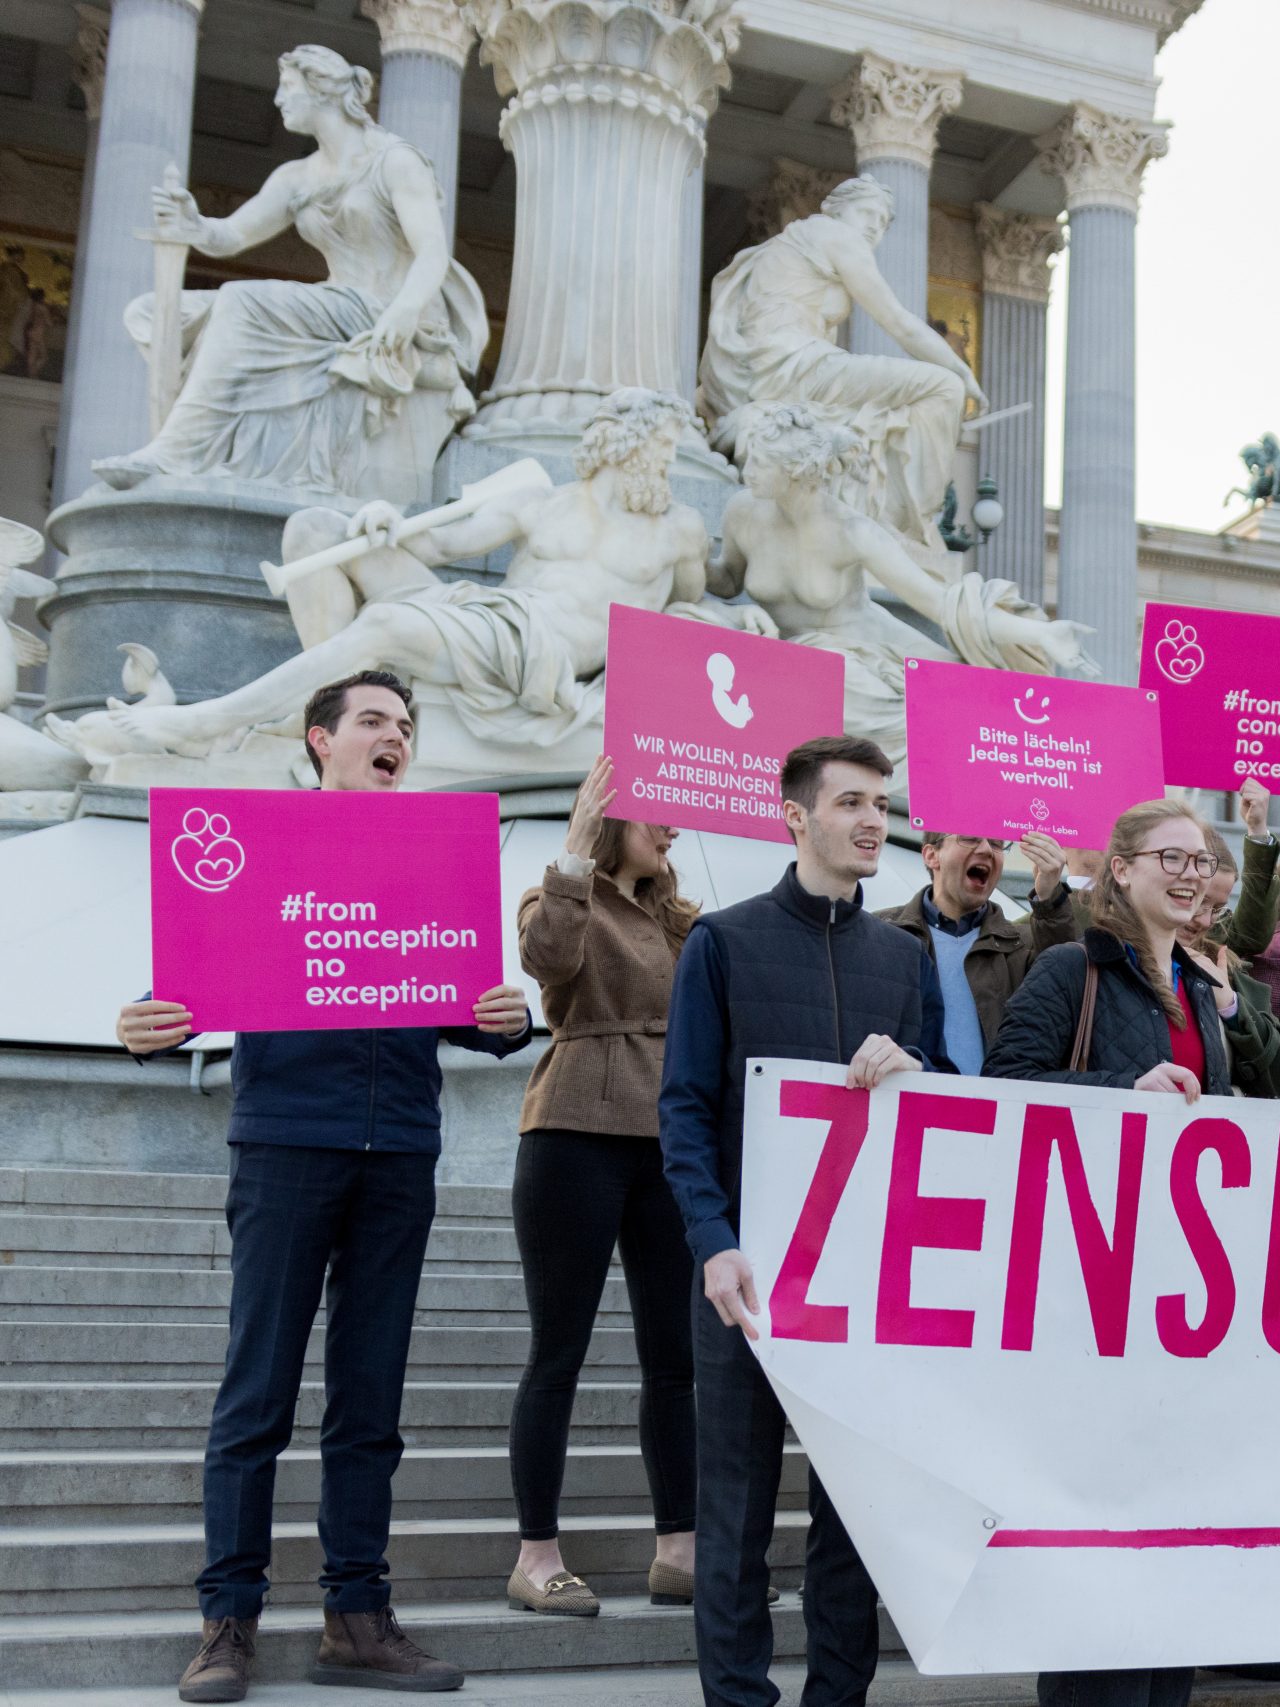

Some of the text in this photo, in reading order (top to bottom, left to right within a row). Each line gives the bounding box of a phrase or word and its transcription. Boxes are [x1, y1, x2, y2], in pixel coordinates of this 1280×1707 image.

[634, 733, 780, 775] WIR WOLLEN, DASS
[979, 727, 1091, 755] Bitte lächeln!
[1236, 738, 1264, 755] no
[968, 744, 1102, 774] Jedes Leben ist
[656, 762, 775, 796] ABTREIBUNGEN
[1000, 770, 1074, 790] wertvoll.
[632, 777, 784, 820] ÖSTERREICH ERÜBRI
[1003, 820, 1034, 830] Marsch
[1052, 825, 1078, 836] Leben
[281, 891, 377, 921] #from
[304, 922, 477, 955] conception
[306, 958, 346, 978] no
[306, 977, 458, 1012] exception
